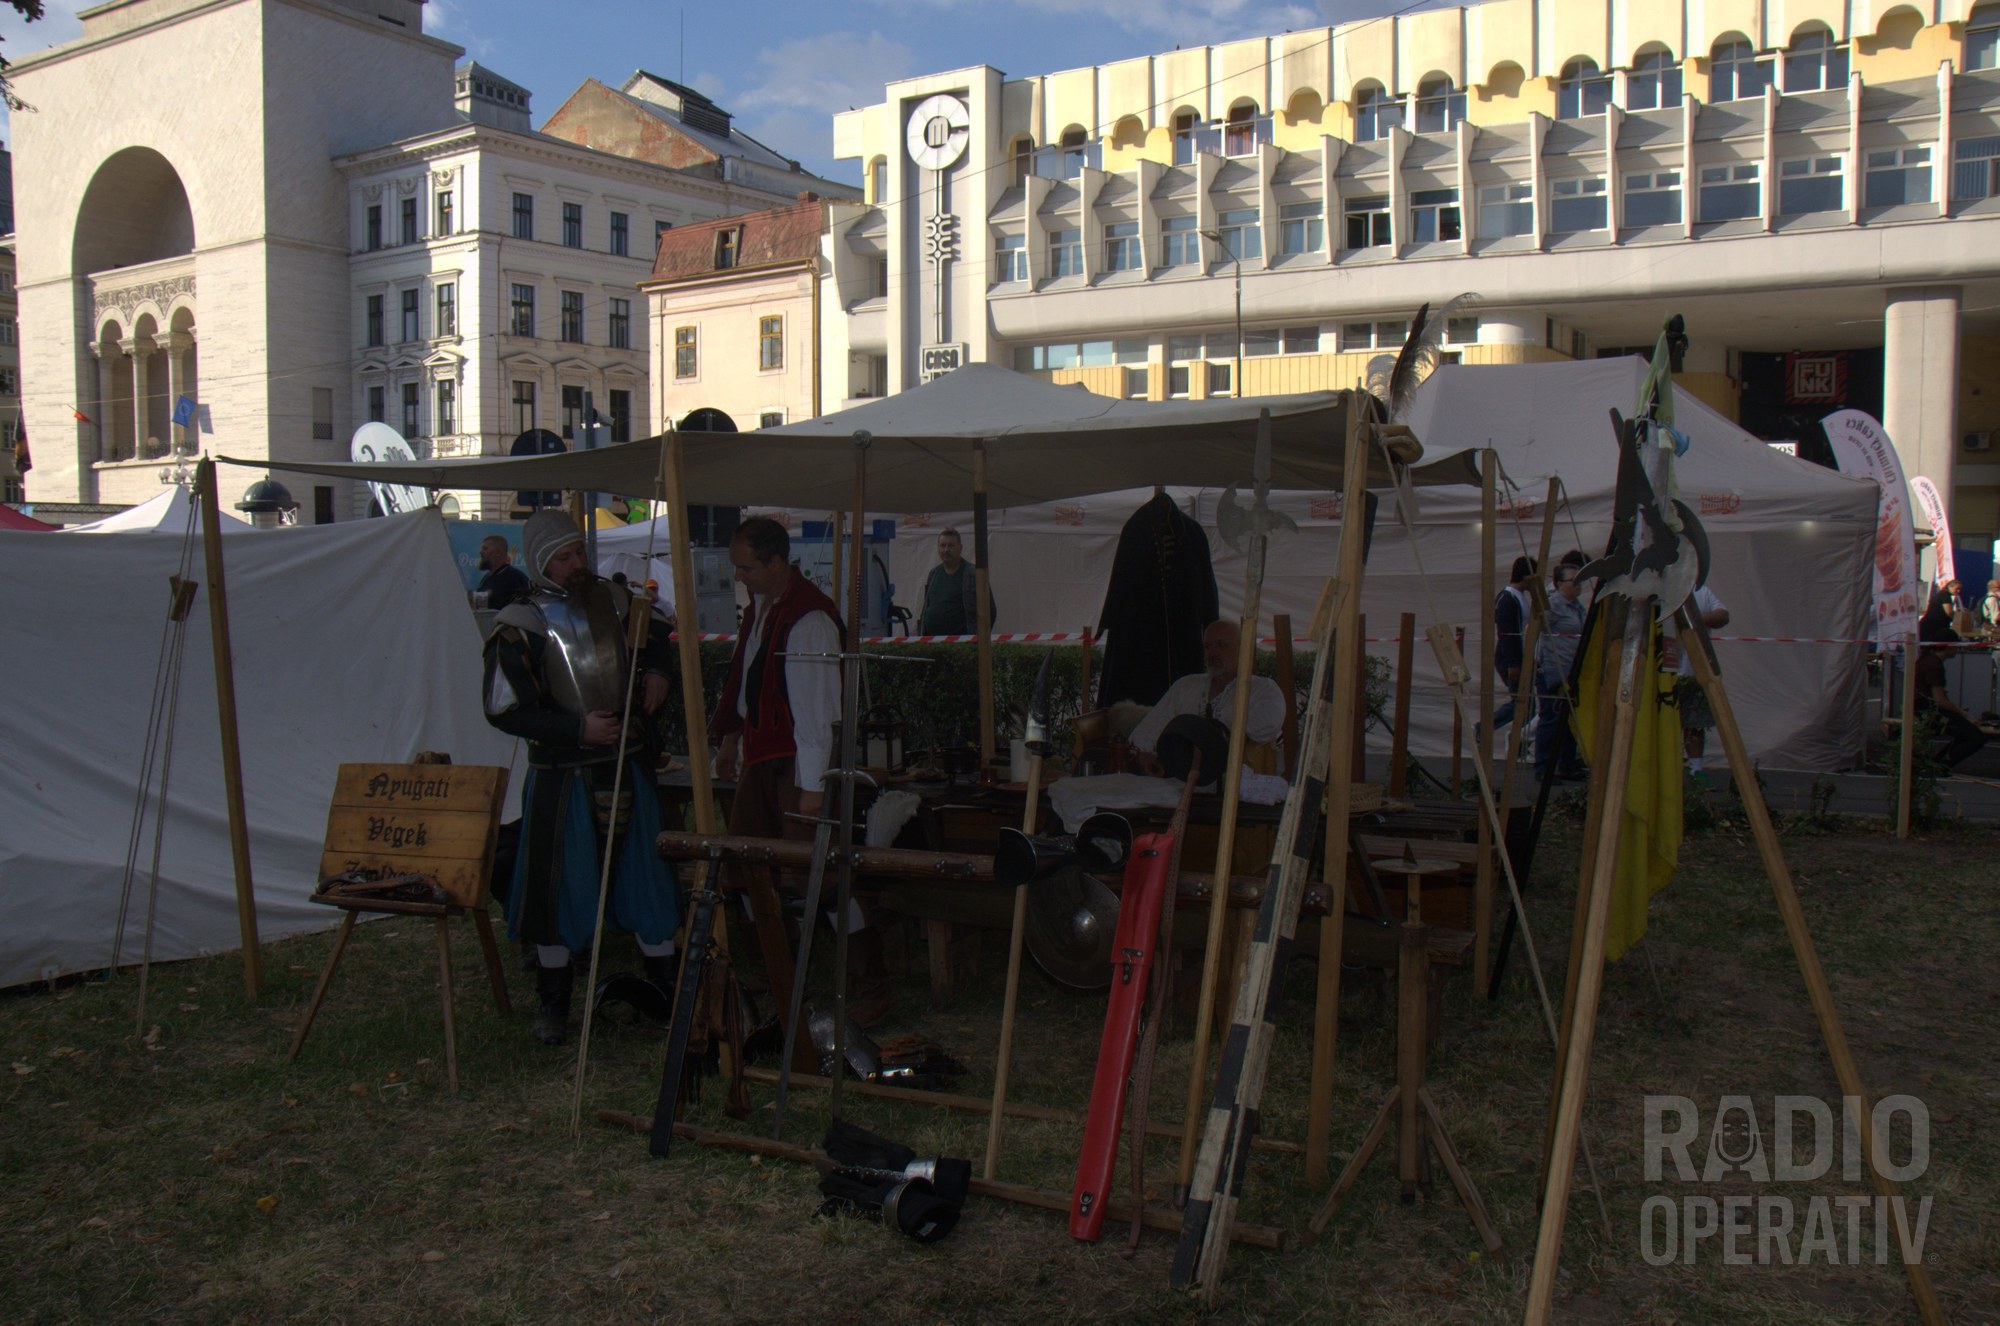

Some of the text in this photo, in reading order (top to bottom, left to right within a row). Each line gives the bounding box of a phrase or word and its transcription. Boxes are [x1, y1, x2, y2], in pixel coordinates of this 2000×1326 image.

[926, 349, 959, 370] CASA
[1800, 362, 1831, 378] FU
[1800, 377, 1830, 393] NK
[364, 772, 451, 801] Nyugati
[368, 815, 428, 848] Végek
